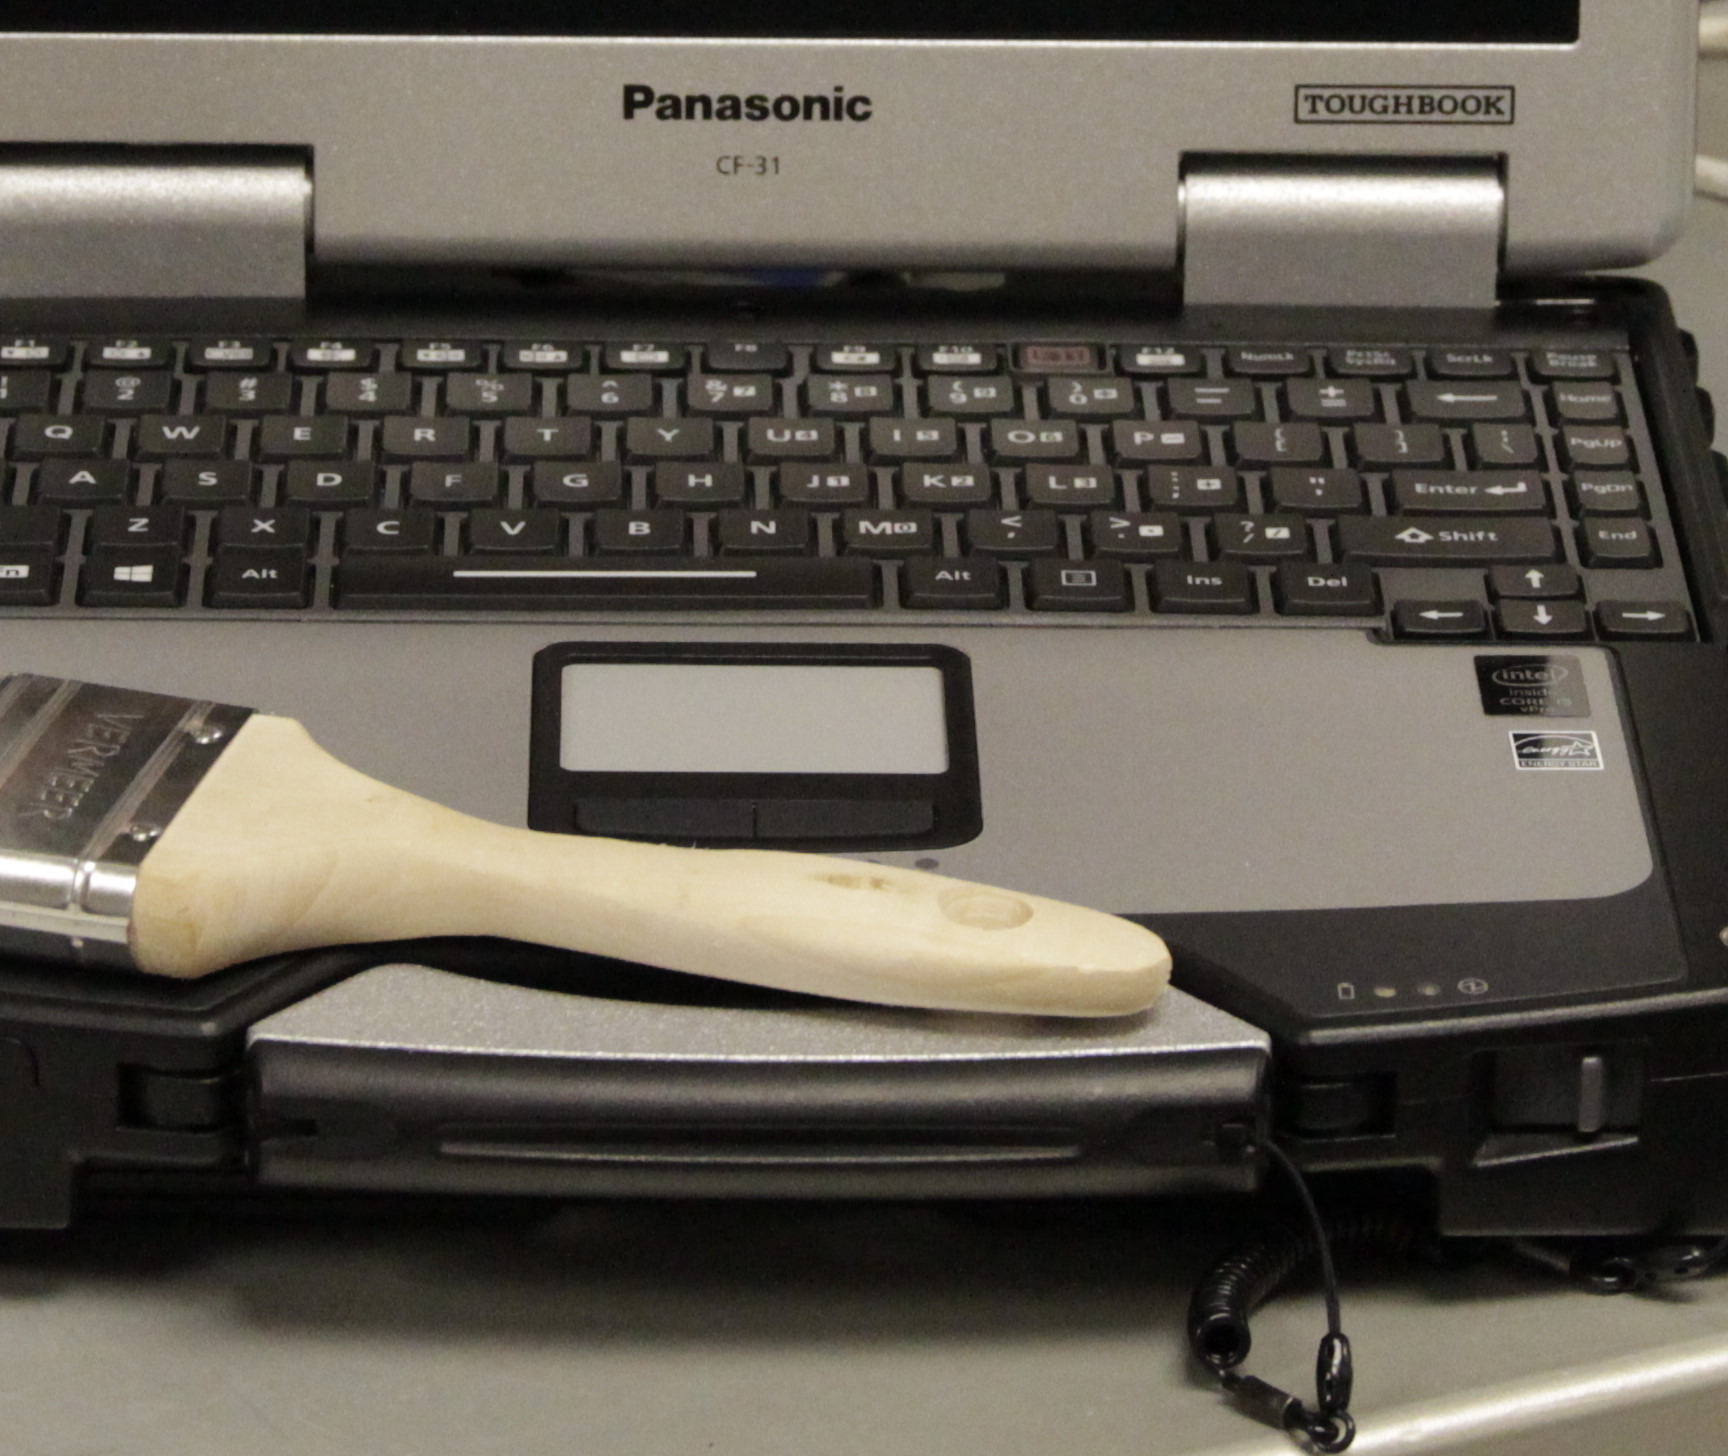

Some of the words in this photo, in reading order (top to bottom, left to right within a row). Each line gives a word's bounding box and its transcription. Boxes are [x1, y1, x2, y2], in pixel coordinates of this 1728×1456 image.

[623, 83, 874, 122] Panasonic
[1303, 93, 1506, 116] TOUGHBOOK
[715, 154, 781, 176] CF-31
[45, 426, 72, 439] Q
[163, 427, 199, 439] W
[294, 428, 310, 440] E
[414, 429, 434, 441] R
[538, 429, 557, 441] T
[658, 429, 678, 441] Y
[767, 429, 791, 441] U
[894, 430, 900, 441] I
[1008, 431, 1035, 443] O
[1134, 432, 1153, 444] P
[70, 471, 95, 483] A
[199, 472, 217, 485] S
[317, 473, 342, 486] D
[445, 475, 460, 487] F
[563, 474, 588, 487] G
[688, 475, 712, 486] H
[808, 475, 819, 487] J
[924, 475, 944, 487] K
[1049, 476, 1065, 489] L
[1415, 483, 1478, 493] Enter
[128, 518, 148, 531] Z
[252, 520, 274, 532] X
[377, 521, 398, 534] C
[501, 522, 525, 535] V
[629, 522, 650, 534] B
[751, 521, 775, 534] N
[859, 521, 892, 534] M
[1439, 531, 1498, 541] Shift
[1599, 531, 1637, 539] End
[242, 569, 276, 578] Alt
[936, 571, 969, 580] Alt
[1187, 575, 1222, 585] Ins
[1308, 577, 1347, 586] Del
